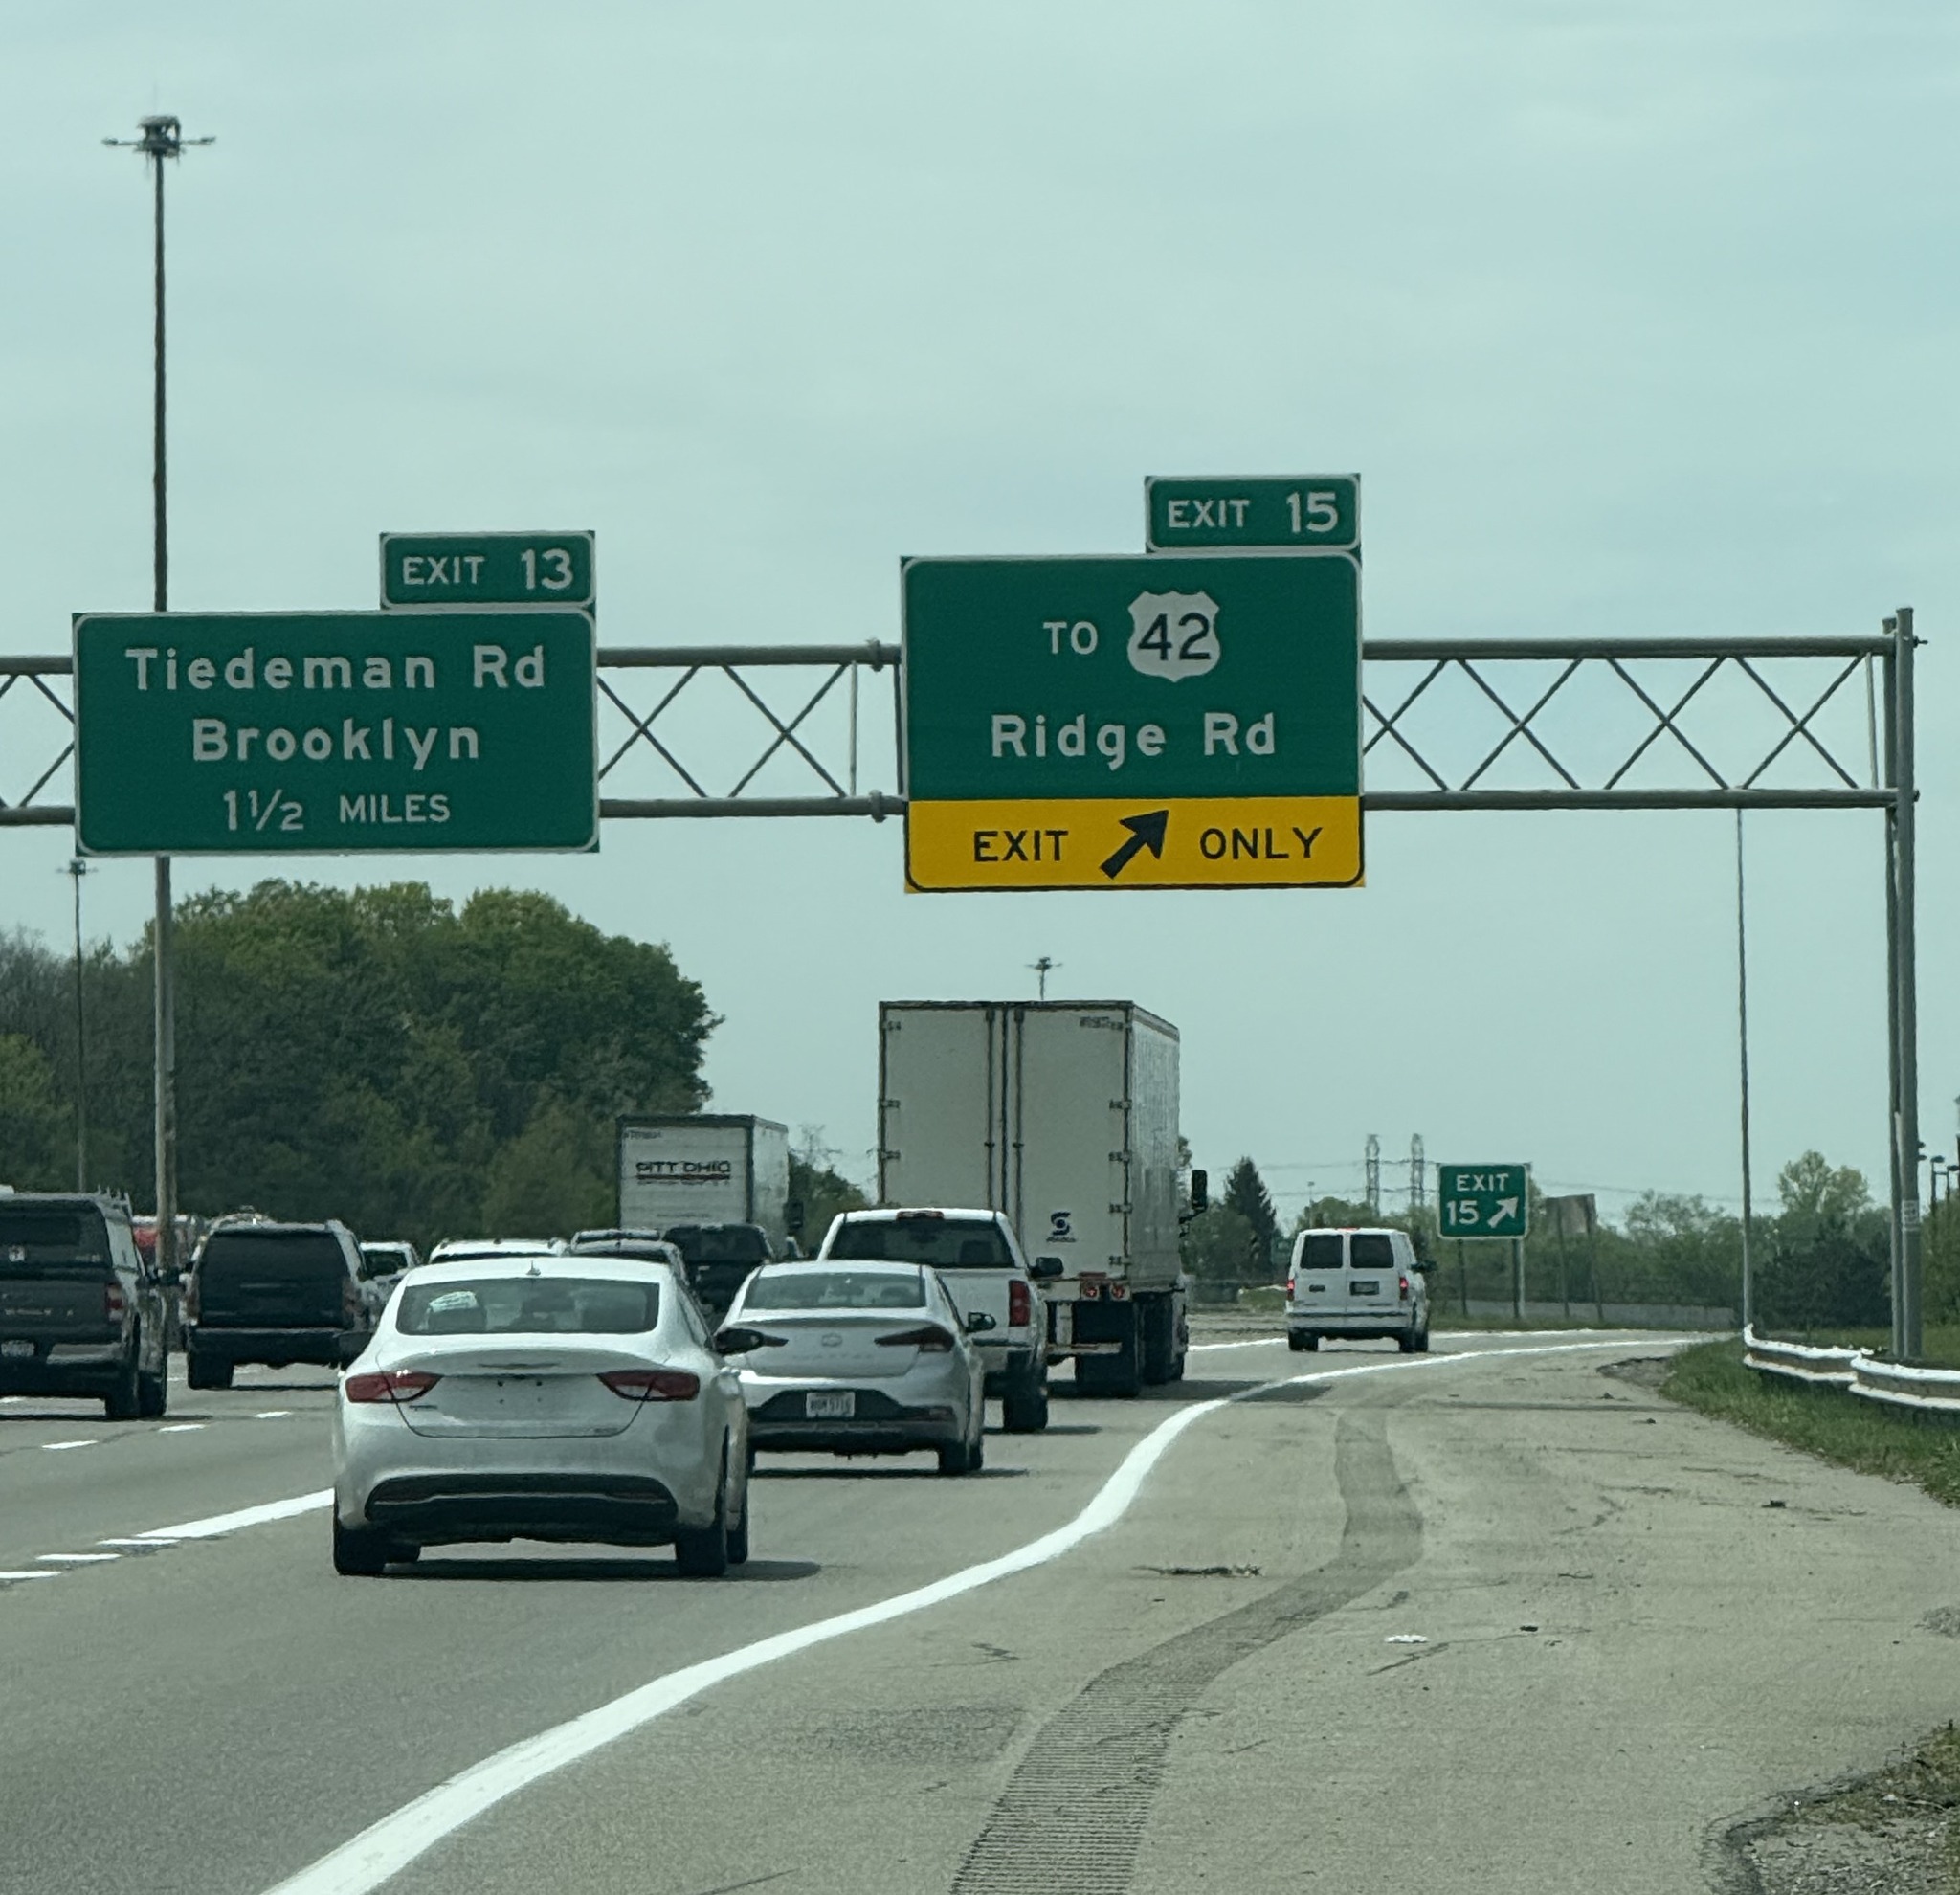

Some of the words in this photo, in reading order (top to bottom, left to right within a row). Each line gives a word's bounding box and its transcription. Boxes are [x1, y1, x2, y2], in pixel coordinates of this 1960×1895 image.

[1168, 499, 1251, 528] EXIT
[1286, 491, 1339, 533] 15
[402, 555, 485, 586] EXIT
[521, 548, 574, 591] 13
[1042, 620, 1099, 655] TO
[1137, 613, 1213, 661] 42
[124, 647, 435, 691] Tiedeman
[473, 644, 546, 688] Rd
[192, 717, 479, 771] Brooklyn
[991, 713, 1167, 771] Ridge
[1204, 712, 1276, 756] Rd
[339, 794, 451, 823] MILES
[973, 829, 1069, 863] EXIT
[1199, 826, 1323, 860] ONLY
[636, 1160, 679, 1173] PITT
[683, 1160, 731, 1173] OHIO
[1456, 1173, 1509, 1192] EXIT
[1446, 1200, 1480, 1226] 15
